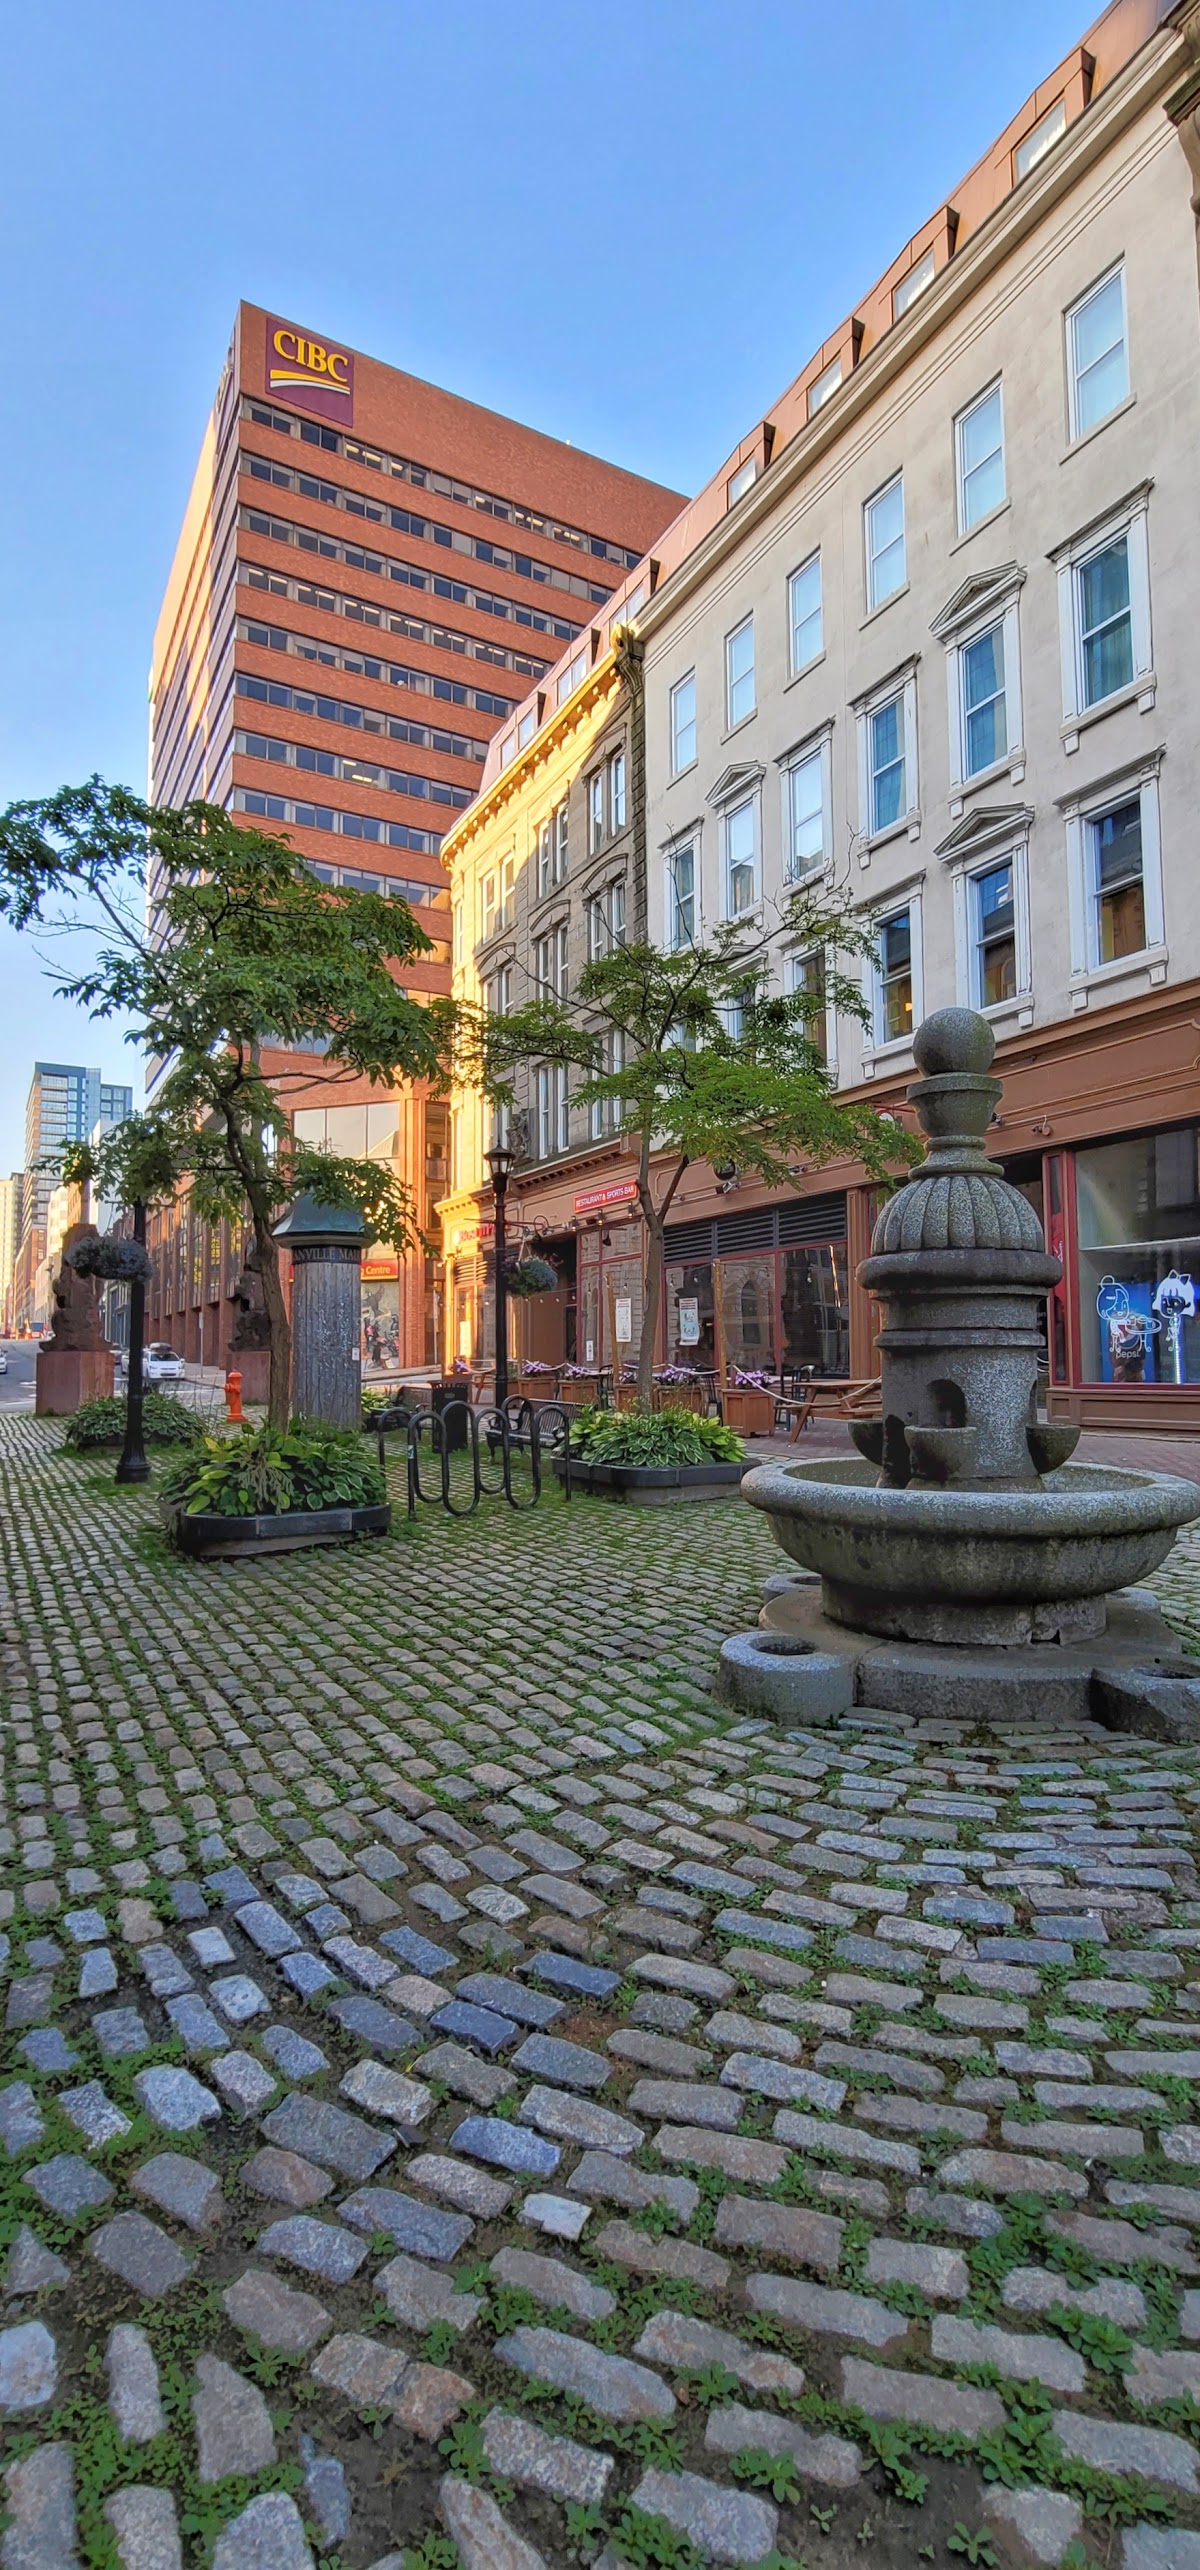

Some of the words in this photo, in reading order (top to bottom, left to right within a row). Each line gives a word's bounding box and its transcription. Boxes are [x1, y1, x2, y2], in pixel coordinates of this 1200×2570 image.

[273, 329, 348, 383] CIBC
[576, 1194, 602, 1206] RESTAURANT
[607, 1188, 624, 1199] SPORTS
[624, 1185, 634, 1195] BAR
[293, 1247, 336, 1260] ANVILLE
[365, 1265, 391, 1275] Centre
[1116, 1351, 1139, 1359] pepsi
